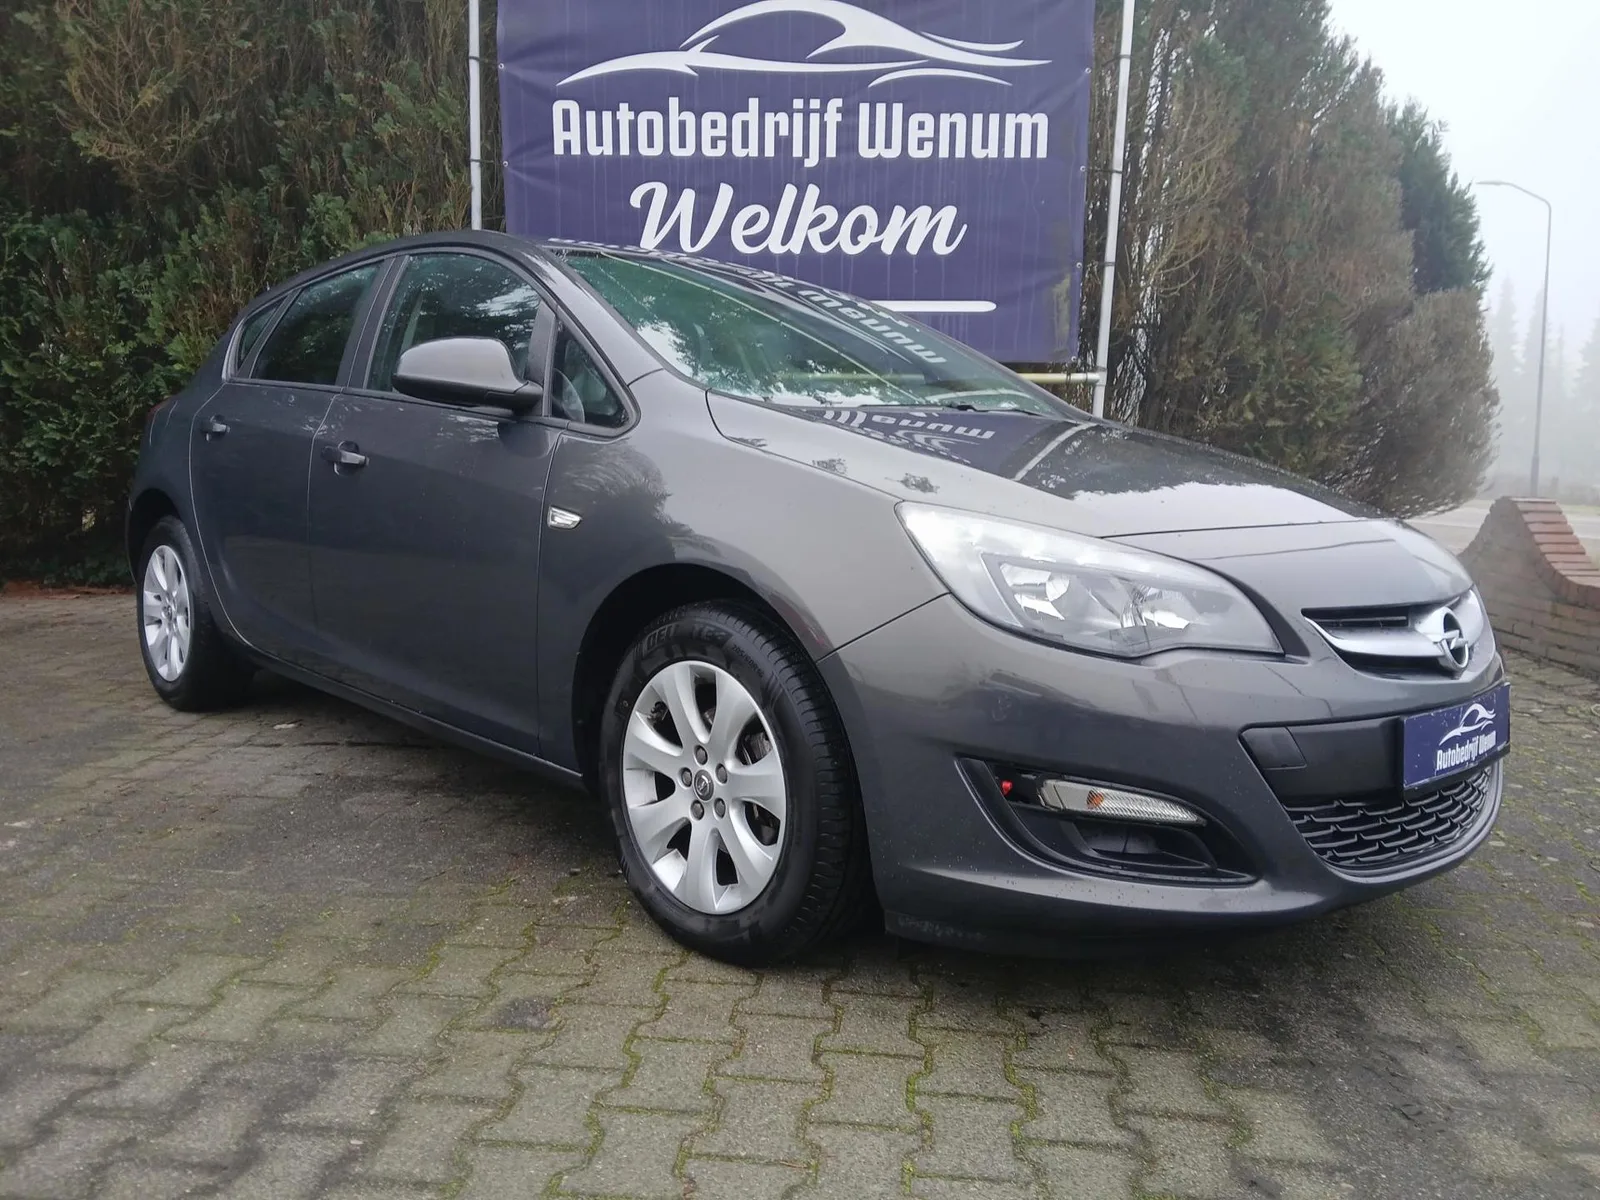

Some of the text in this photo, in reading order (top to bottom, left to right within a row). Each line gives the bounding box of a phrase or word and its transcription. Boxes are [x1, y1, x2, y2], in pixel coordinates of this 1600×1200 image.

[552, 97, 1049, 168] Autobedrijf Wenum
[629, 182, 968, 256] Welkom
[1436, 735, 1479, 770] Autobedrijf
